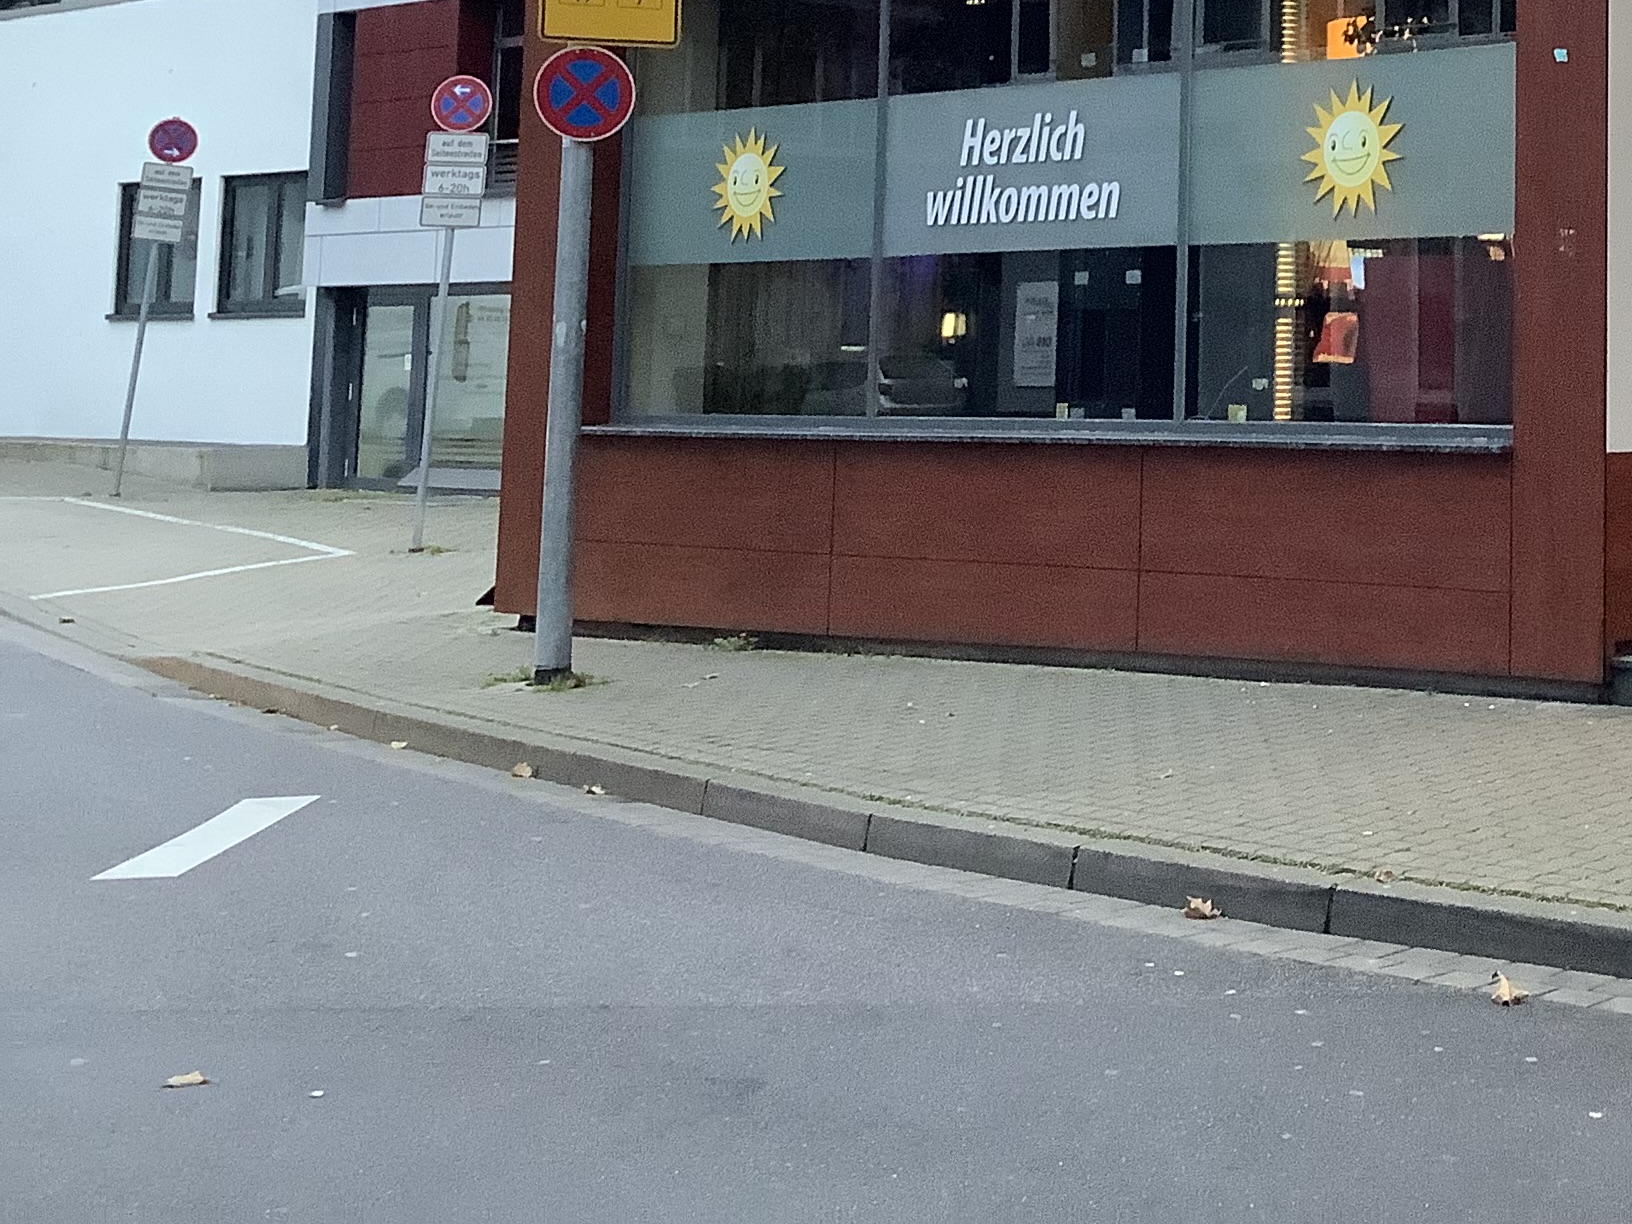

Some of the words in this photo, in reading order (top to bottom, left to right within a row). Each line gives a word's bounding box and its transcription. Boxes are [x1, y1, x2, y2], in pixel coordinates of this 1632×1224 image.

[959, 110, 1086, 167] Herzlich
[430, 168, 481, 181] werktags
[926, 174, 1121, 226] willkommen
